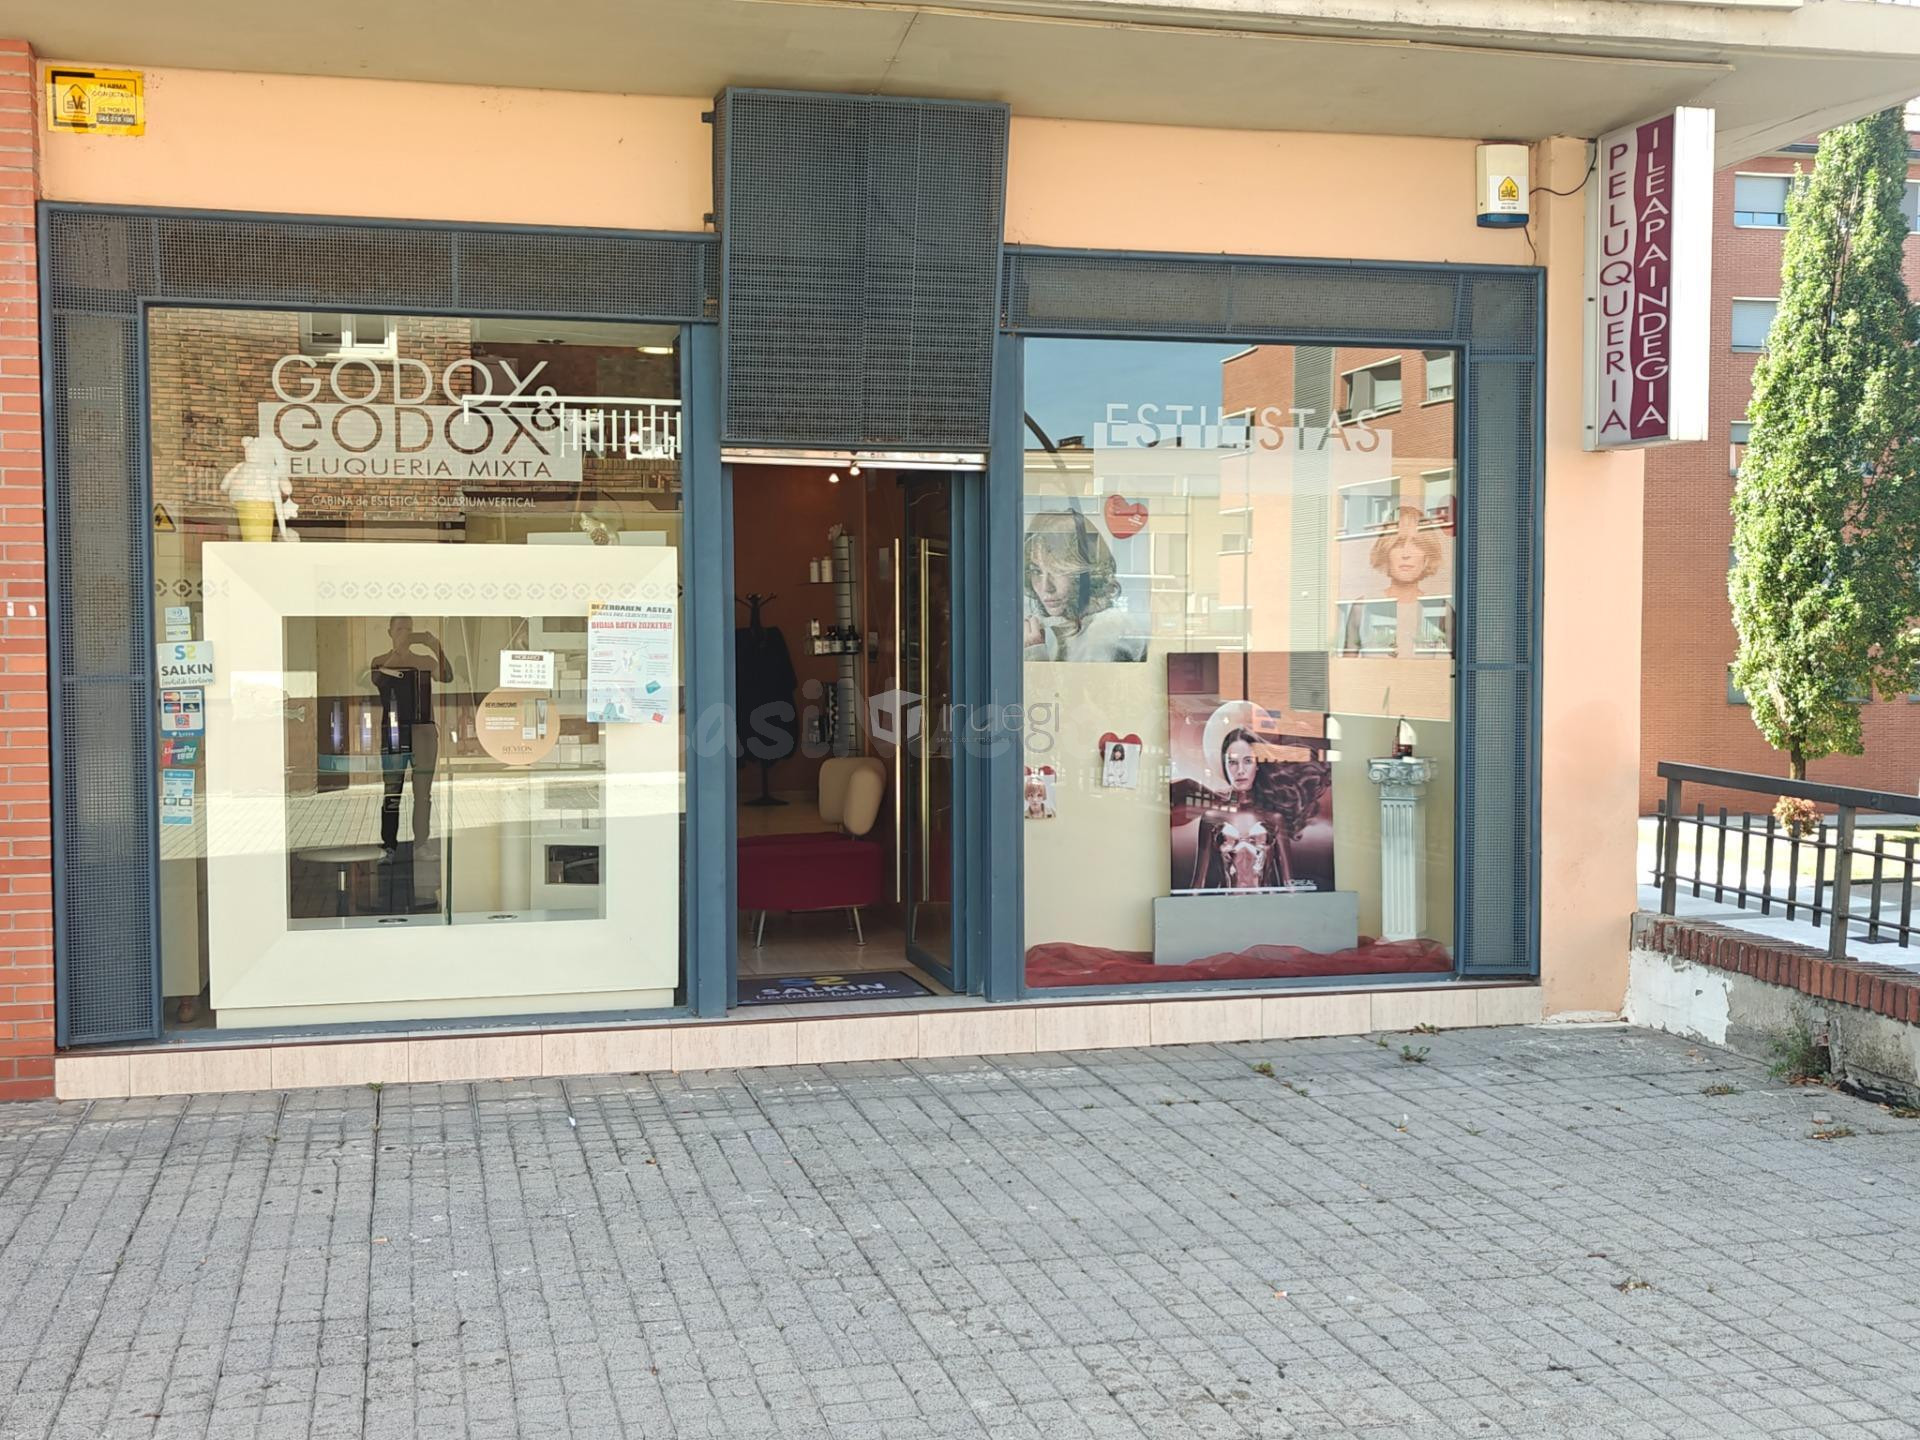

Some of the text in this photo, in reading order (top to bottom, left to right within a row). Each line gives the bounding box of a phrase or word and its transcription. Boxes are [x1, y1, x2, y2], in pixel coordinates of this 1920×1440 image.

[1600, 143, 1632, 433] PELUQUERIA
[1635, 127, 1669, 428] ILEAPAINDEGIA
[271, 354, 549, 408] GODOY
[1106, 402, 1380, 453] ESTILISTAS
[274, 455, 552, 478] ELUQUERIA MIXTA
[311, 495, 354, 507] CABINA
[356, 495, 368, 507] de
[431, 496, 486, 507] SOLARIUM
[488, 497, 536, 508] VERTICAL
[161, 664, 213, 676] SALKIN
[761, 983, 886, 995] SALKIN
